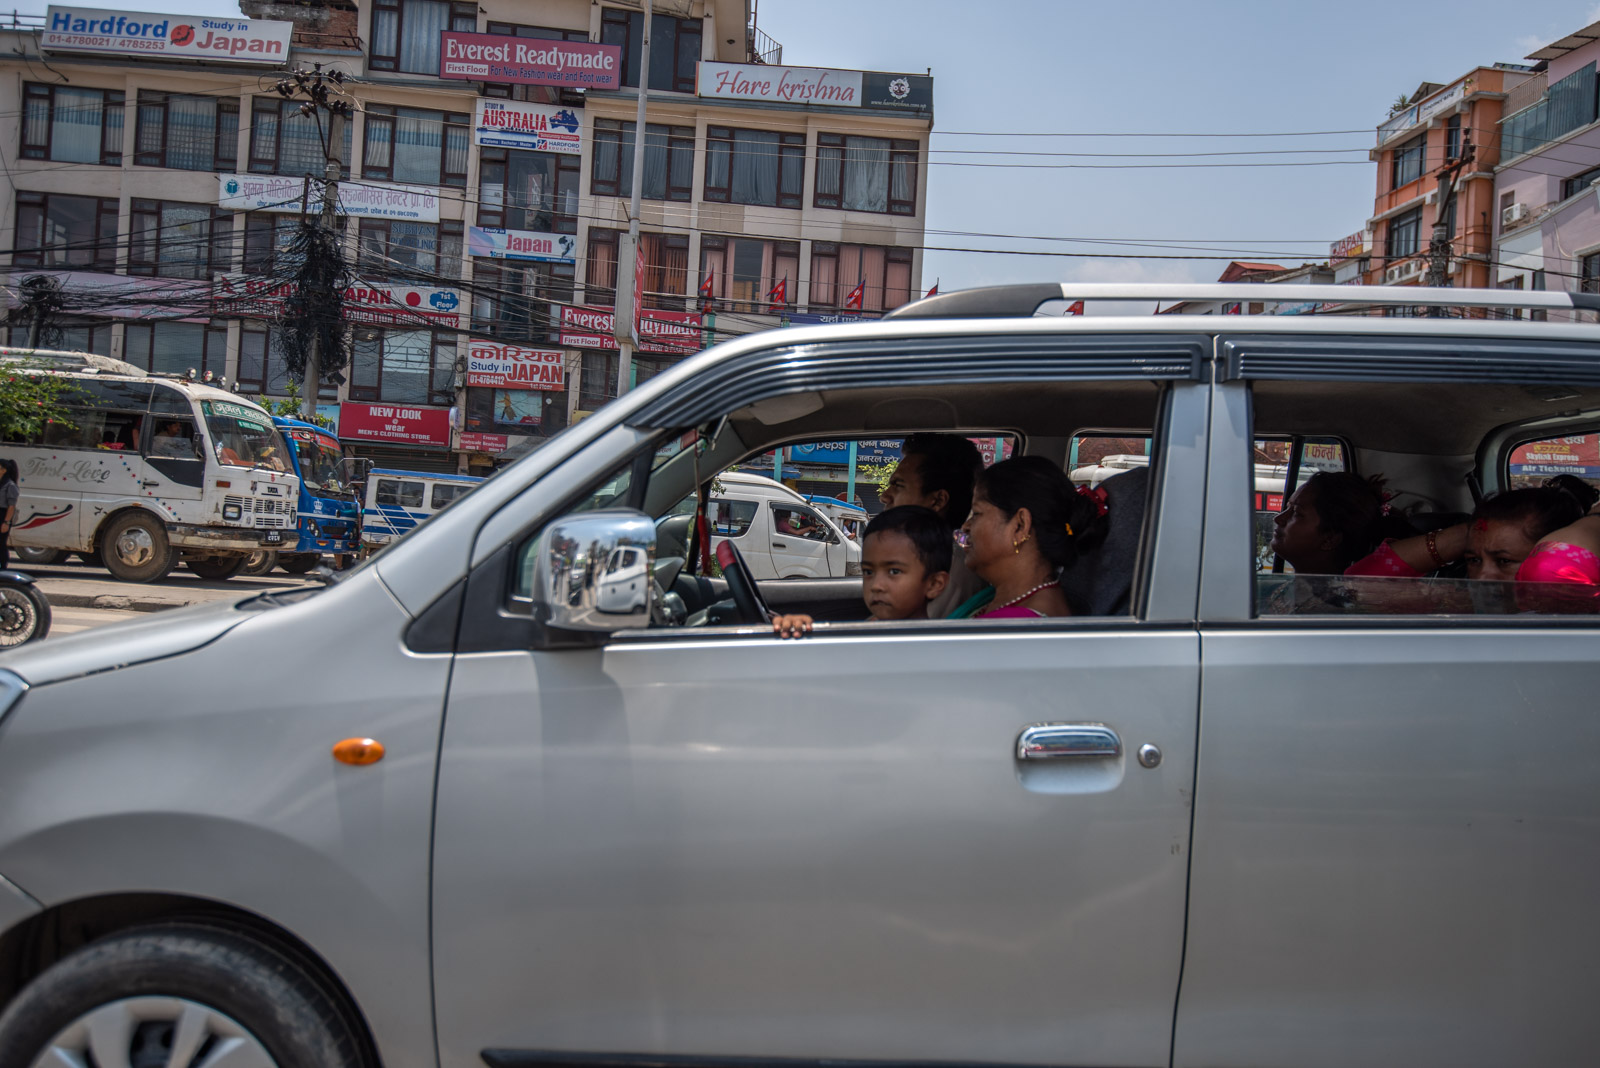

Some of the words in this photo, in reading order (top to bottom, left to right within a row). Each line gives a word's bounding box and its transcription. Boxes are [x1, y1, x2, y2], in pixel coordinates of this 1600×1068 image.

[51, 12, 169, 38] Hardford
[202, 20, 234, 31] Study
[236, 22, 248, 31] in
[49, 34, 110, 48] 01-4780021
[118, 38, 166, 50] 4785253
[196, 32, 282, 55] Japan
[446, 38, 510, 62] Everest
[515, 44, 614, 72] Readymade
[447, 64, 465, 72] First
[466, 65, 487, 74] Floor
[490, 66, 500, 75] For
[503, 67, 518, 77] New
[520, 68, 545, 80] Fashion
[547, 72, 564, 80] wear
[566, 71, 578, 82] and
[580, 72, 594, 83] Foot
[596, 74, 612, 84] wear
[716, 70, 770, 96] Hare
[776, 70, 854, 101] krishna
[482, 109, 548, 131] AUSTRALIA
[506, 234, 552, 253] Japan
[564, 308, 615, 331] Everest
[603, 338, 614, 348] For
[471, 344, 562, 364] कोरियन
[471, 362, 500, 373] Study
[502, 364, 512, 372] in
[507, 363, 564, 382] JAPAN
[369, 406, 394, 418] NEW
[396, 409, 422, 420] LOOK
[22, 456, 68, 477] First
[67, 460, 110, 483] Love
[1538, 466, 1586, 474] Ticketing
